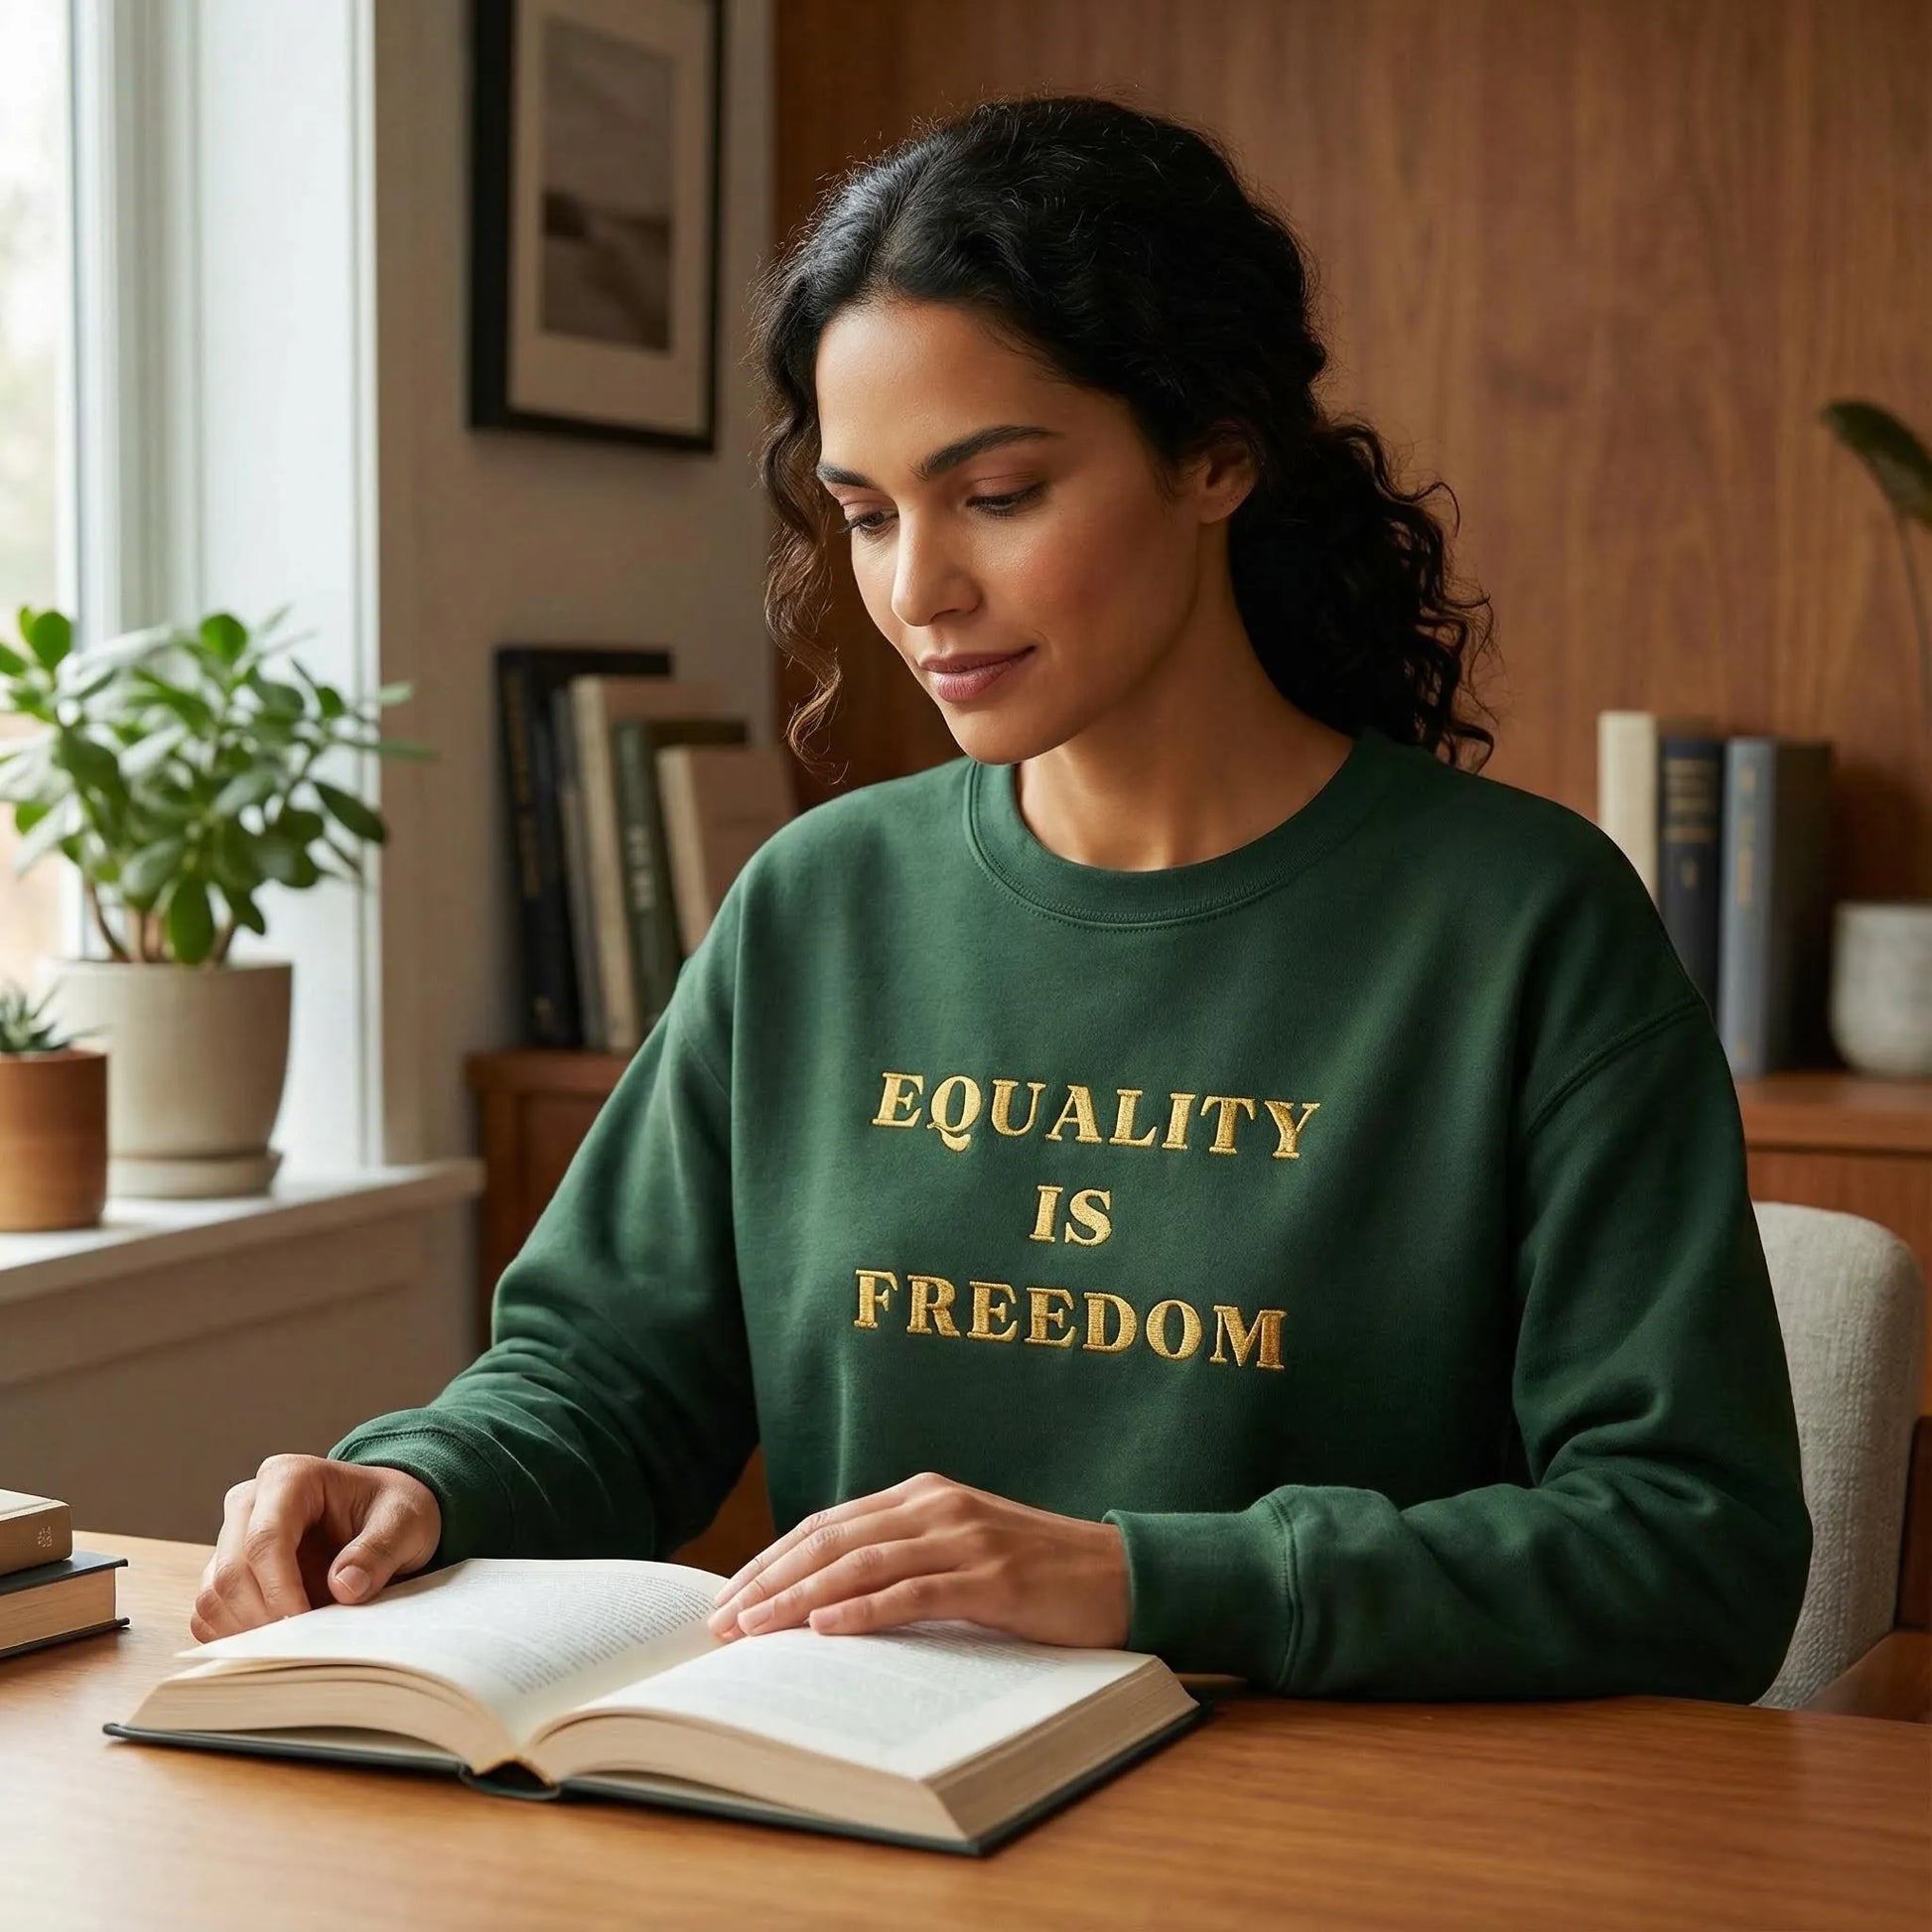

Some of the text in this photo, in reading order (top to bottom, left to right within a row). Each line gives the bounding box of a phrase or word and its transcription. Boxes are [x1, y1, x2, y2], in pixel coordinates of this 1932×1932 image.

[872, 1071, 1321, 1159] EQUALITY
[1029, 1184, 1113, 1246] IS
[853, 1269, 1288, 1370] FREEDOM
